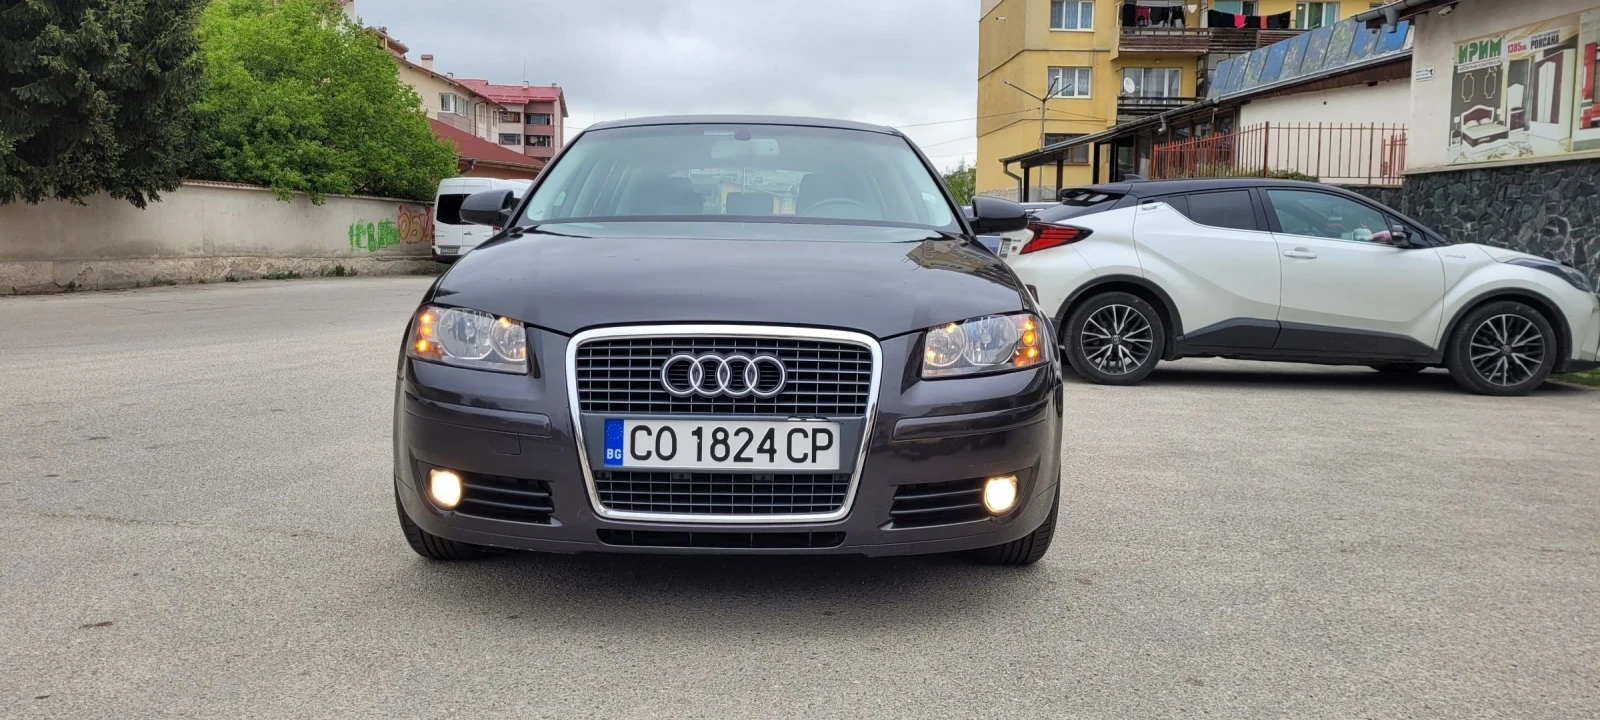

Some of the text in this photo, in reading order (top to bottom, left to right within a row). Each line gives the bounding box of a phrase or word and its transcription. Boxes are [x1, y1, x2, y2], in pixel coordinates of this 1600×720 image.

[1459, 37, 1502, 63] ИРИМ
[1530, 34, 1560, 50] РОКСАНА
[606, 449, 622, 460] BG
[630, 425, 834, 464] CO 1824 CP
